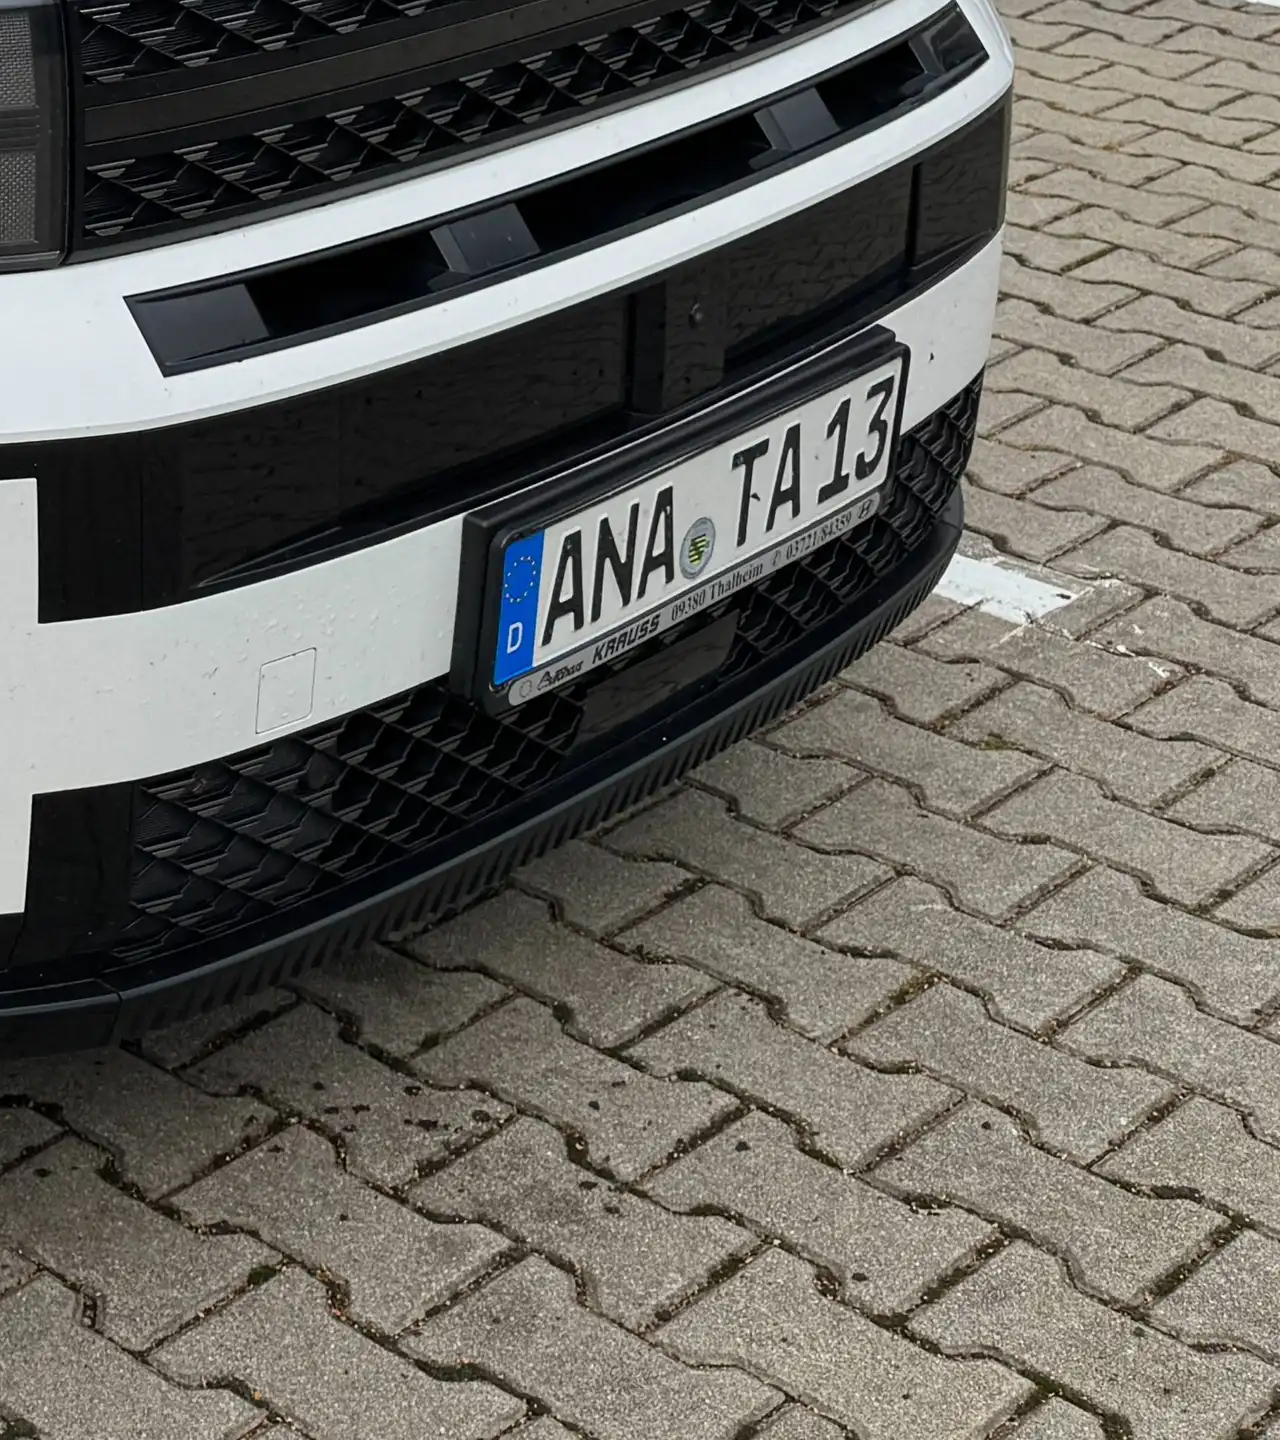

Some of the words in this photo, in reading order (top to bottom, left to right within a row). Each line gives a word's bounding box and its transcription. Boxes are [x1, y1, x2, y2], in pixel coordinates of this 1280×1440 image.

[541, 486, 676, 647] ANA
[731, 424, 802, 547] TA
[817, 376, 895, 506] 13
[507, 621, 523, 654] D
[592, 614, 661, 665] KRAUSS
[671, 589, 706, 622] 09380
[710, 562, 763, 601] Thalheim
